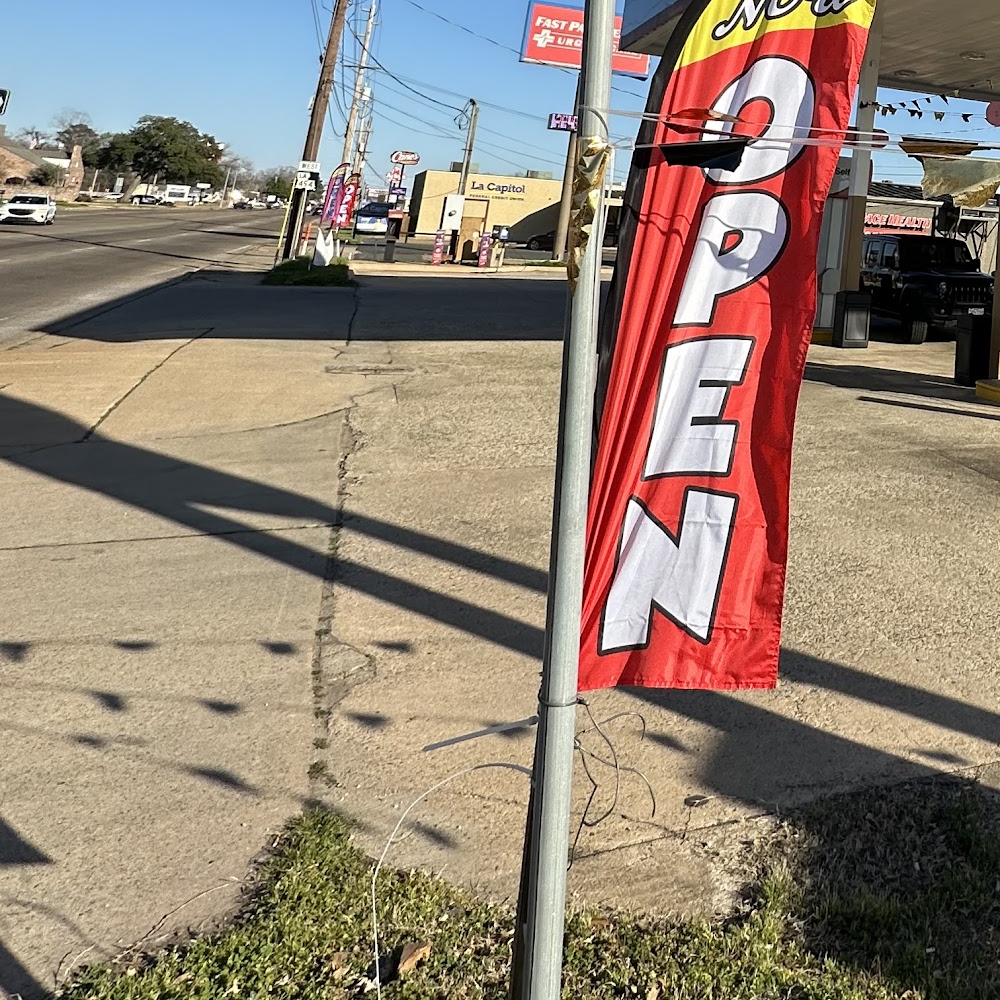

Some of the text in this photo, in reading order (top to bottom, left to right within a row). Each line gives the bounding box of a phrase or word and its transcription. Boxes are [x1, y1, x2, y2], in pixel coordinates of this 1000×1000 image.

[535, 16, 568, 30] FAST
[835, 167, 851, 176] Self
[471, 181, 526, 194] La Capitol
[336, 184, 355, 223] OPEN
[597, 55, 816, 655] OPEN
